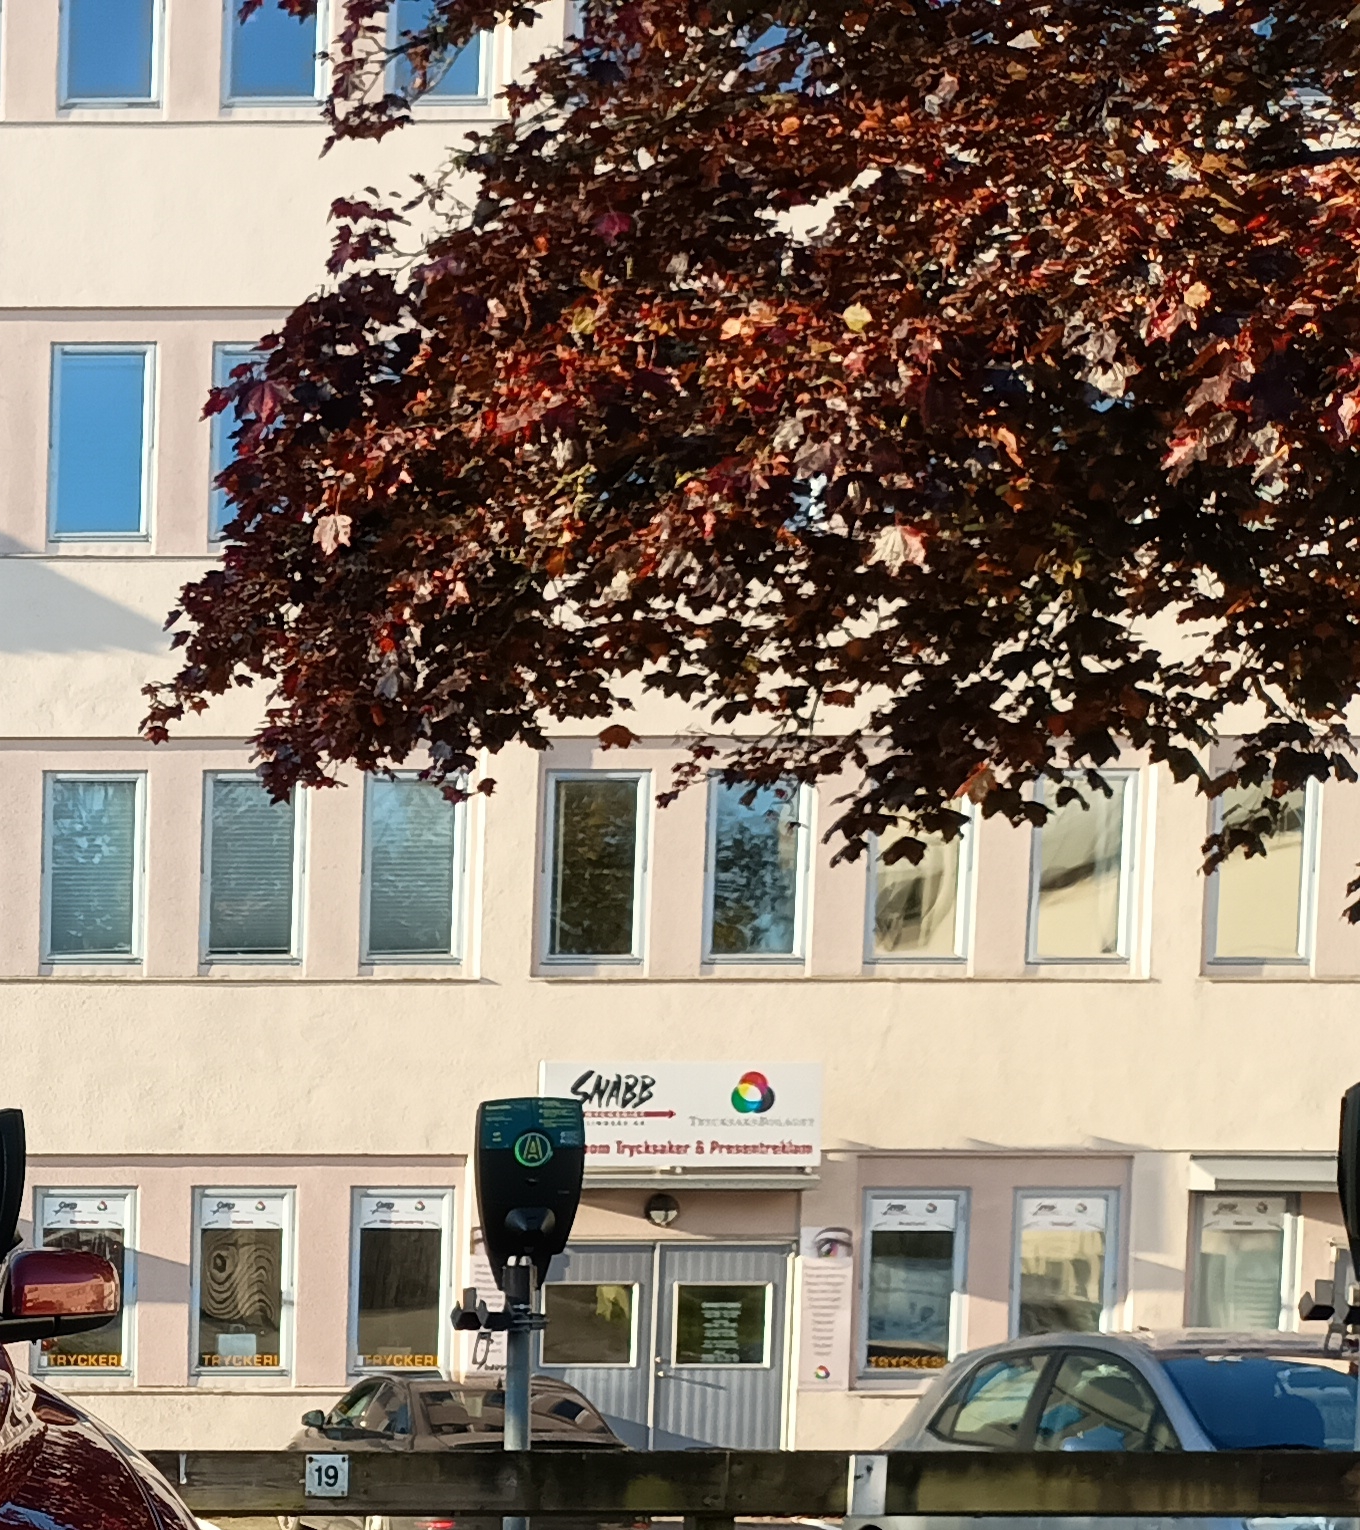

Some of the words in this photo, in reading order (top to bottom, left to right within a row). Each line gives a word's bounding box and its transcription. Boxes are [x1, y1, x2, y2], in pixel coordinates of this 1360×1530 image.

[616, 1140, 690, 1157] Trycksaker
[202, 1354, 278, 1366] TRYCKERI
[315, 1465, 339, 1487] 19
